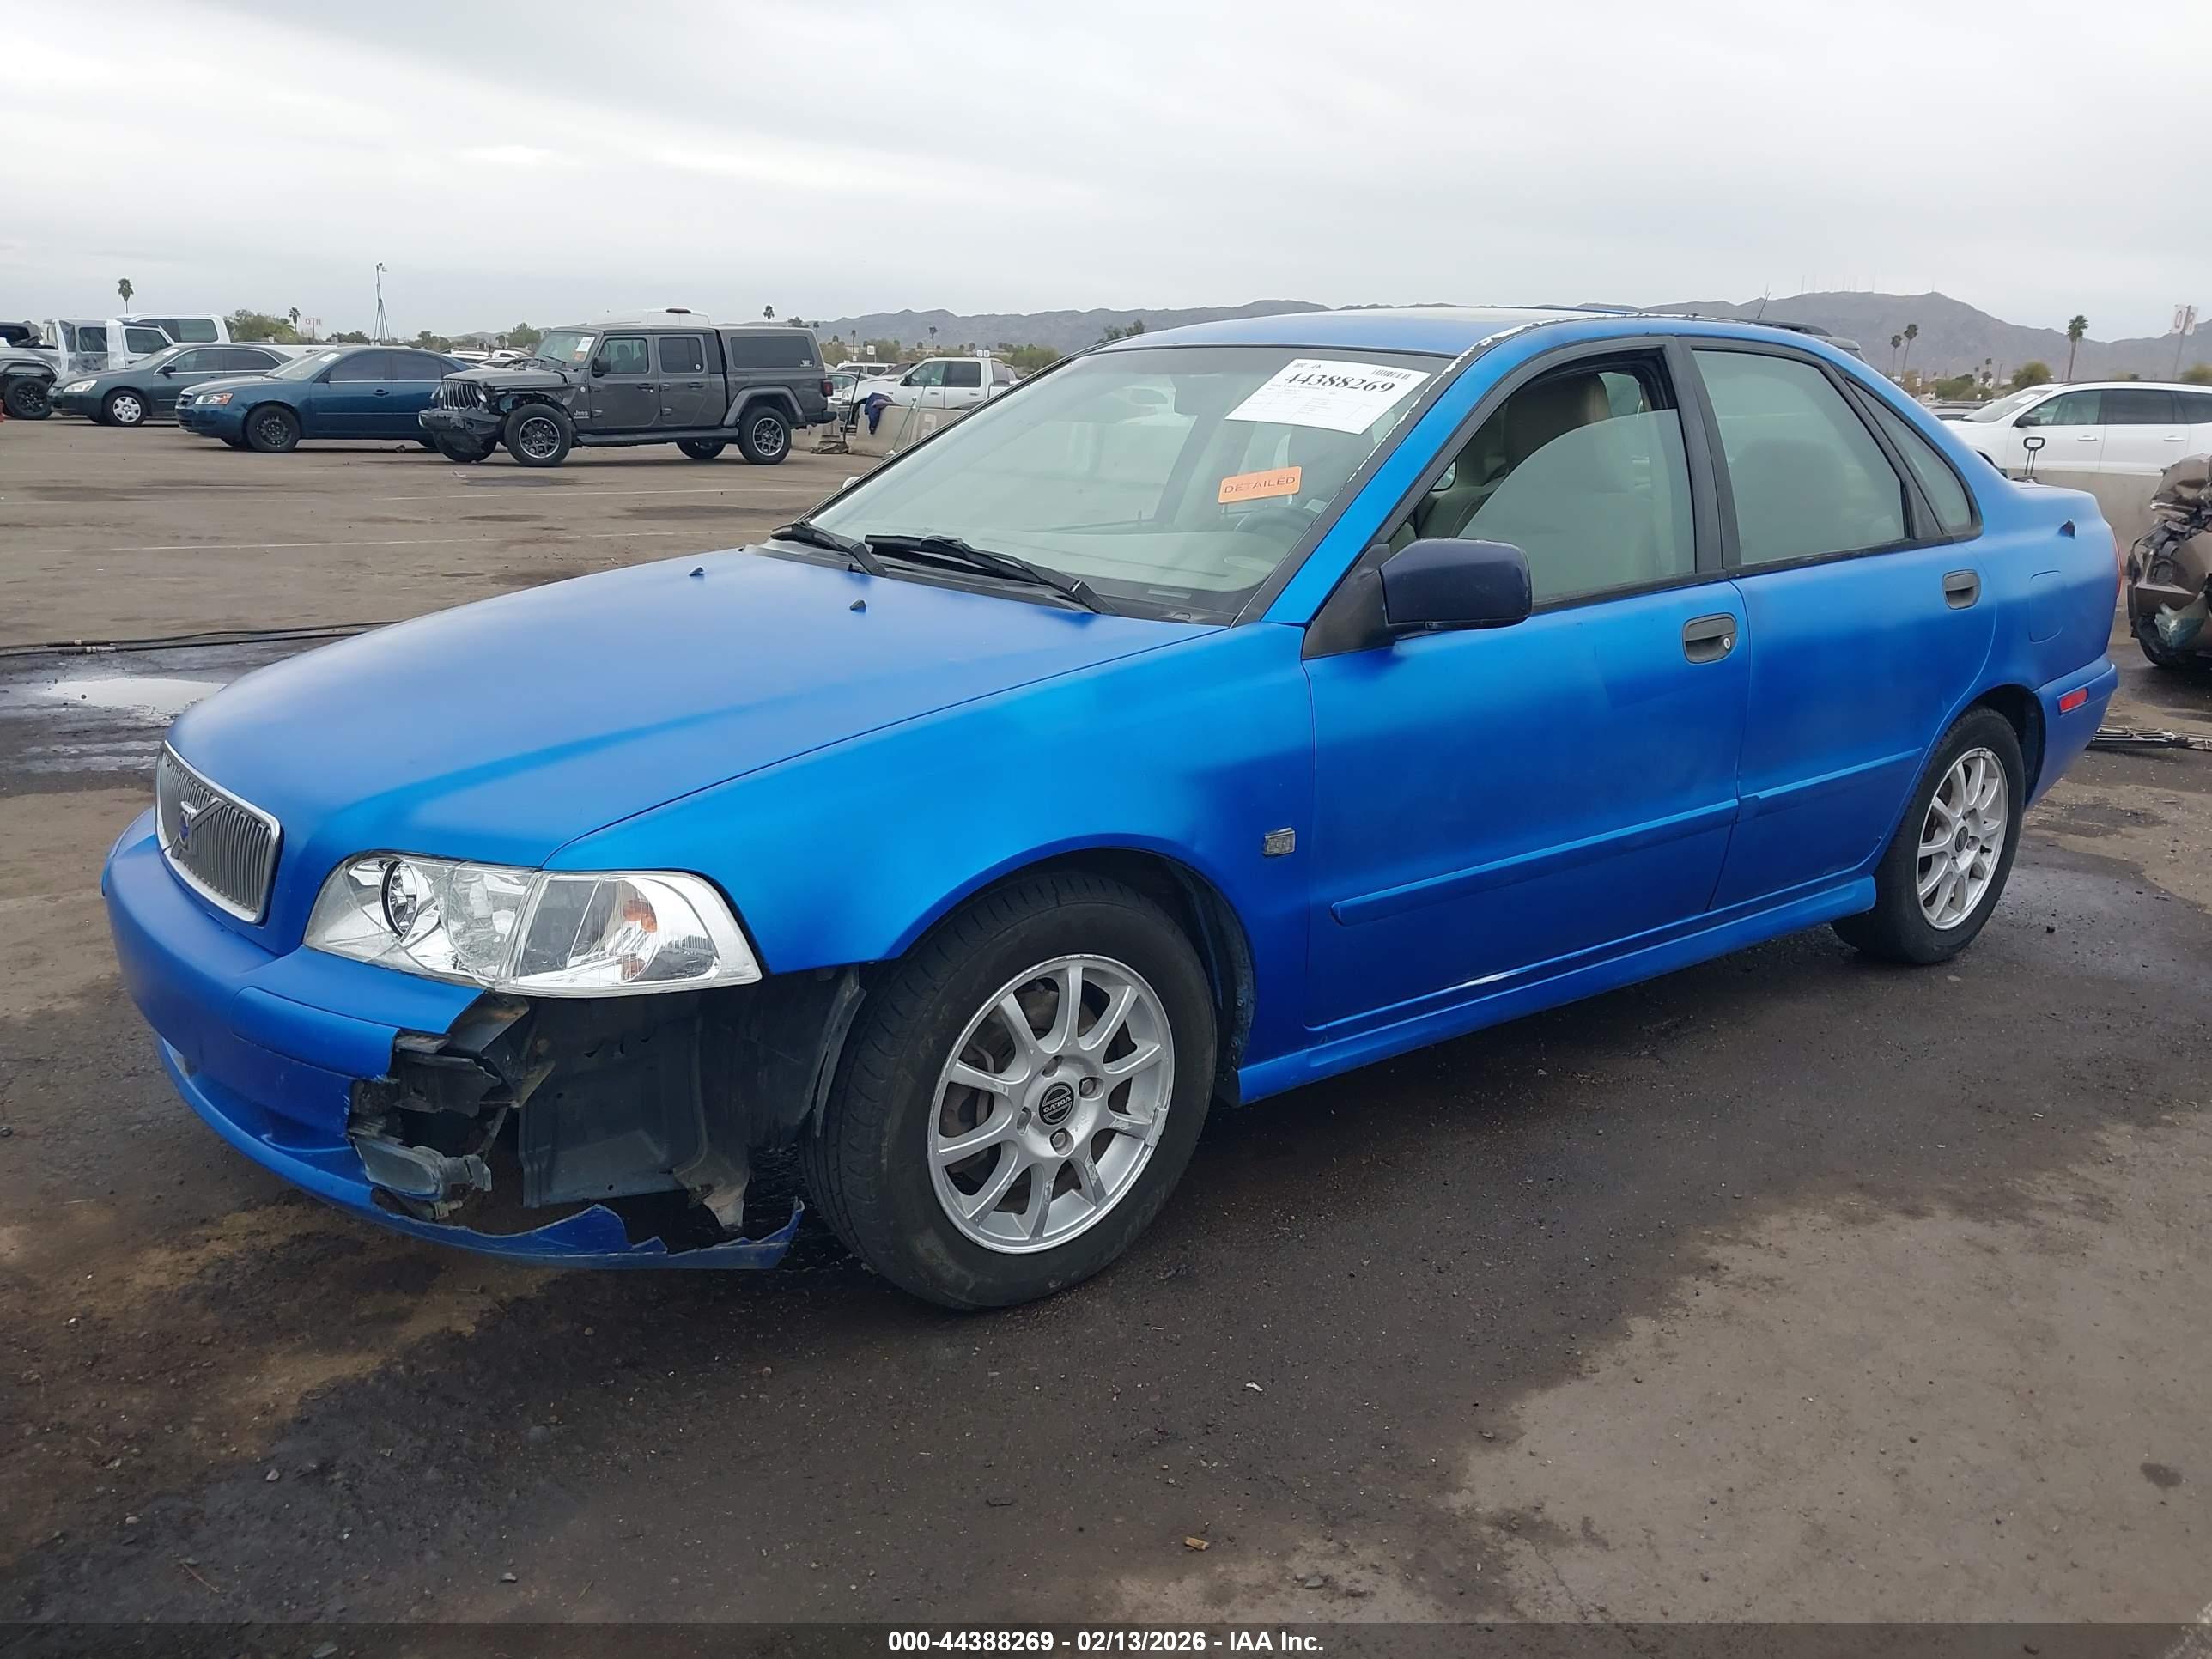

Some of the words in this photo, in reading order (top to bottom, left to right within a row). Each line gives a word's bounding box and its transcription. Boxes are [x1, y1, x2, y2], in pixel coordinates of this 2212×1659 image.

[1285, 372, 1395, 392] 44388269
[1224, 476, 1296, 494] DETAILED
[1043, 1096, 1073, 1113] VOLVO
